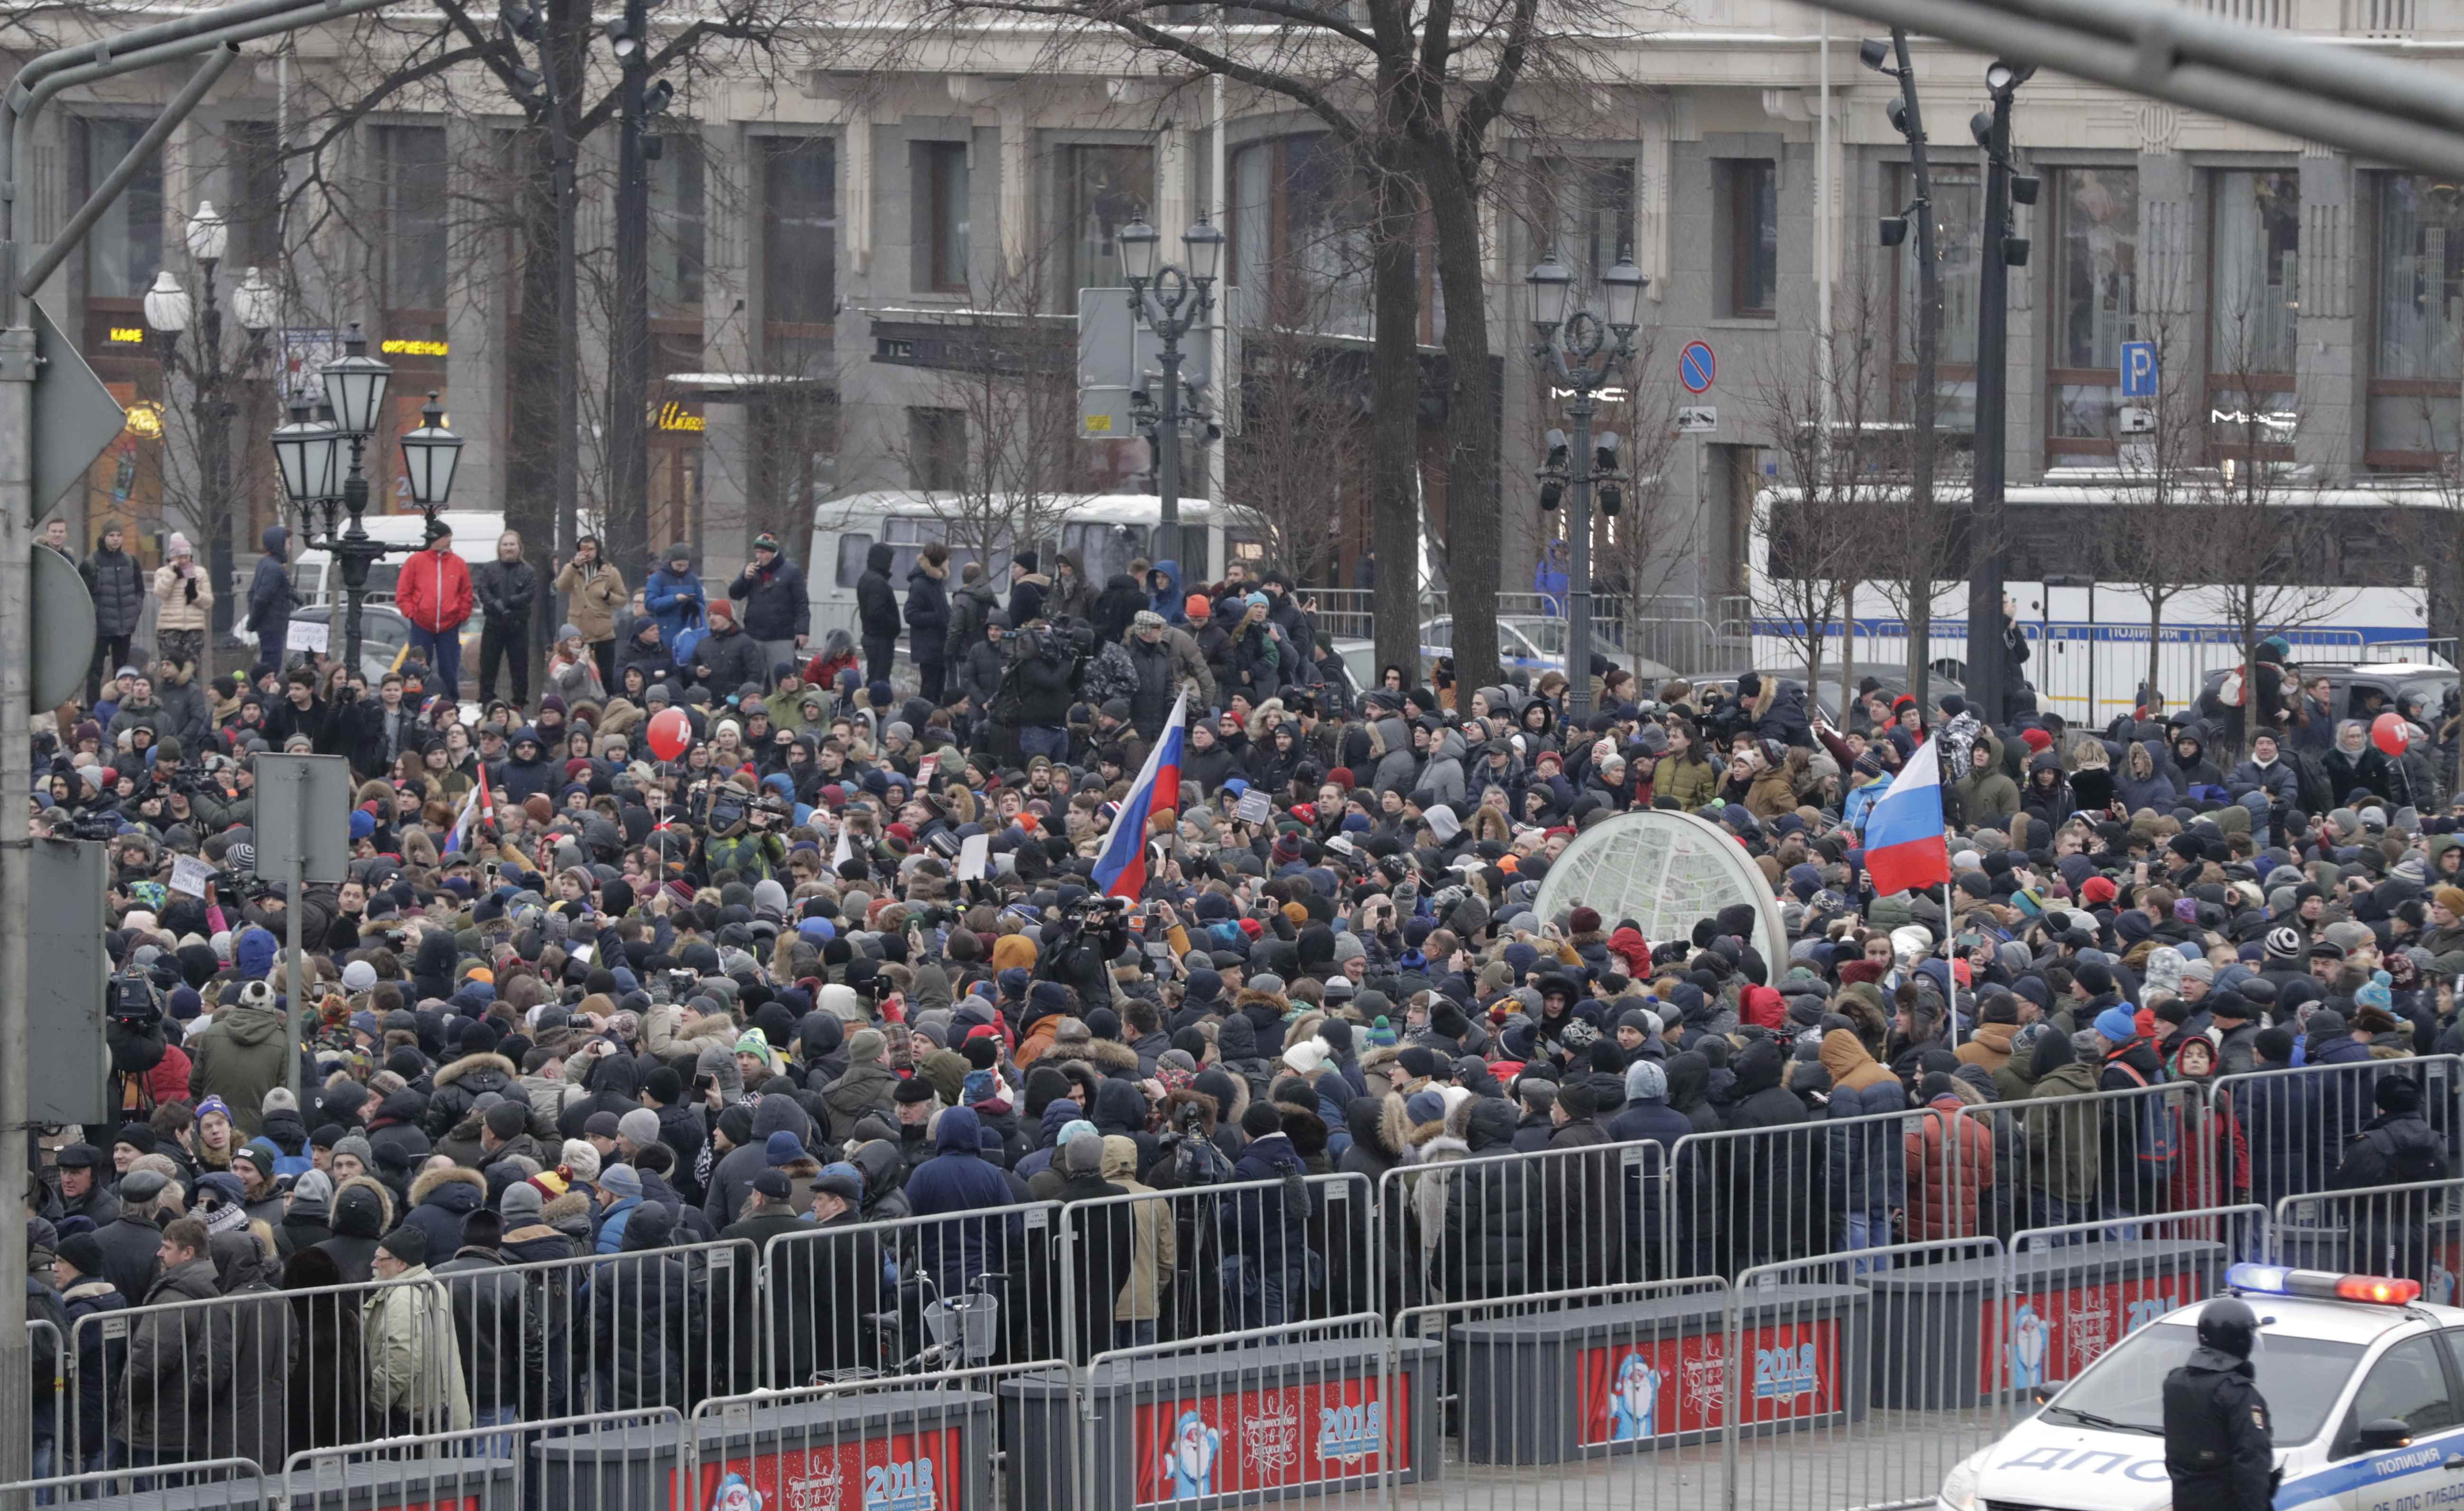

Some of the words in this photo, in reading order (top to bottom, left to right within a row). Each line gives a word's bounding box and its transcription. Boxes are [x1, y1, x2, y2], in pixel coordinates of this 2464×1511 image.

[381, 340, 448, 356] ФИРМЕННЫ
[2131, 348, 2151, 392] P
[2109, 626, 2178, 638] ПОЛИИЯ
[1757, 1343, 1816, 1382] 2018
[1318, 1401, 1379, 1443] 2018
[1325, 1444, 1356, 1453] МОСКОСКИЕ
[1999, 1447, 2172, 1482] ДПС
[2376, 1448, 2441, 1476] ПОЛИЦИЯ
[867, 1458, 933, 1502] 2018
